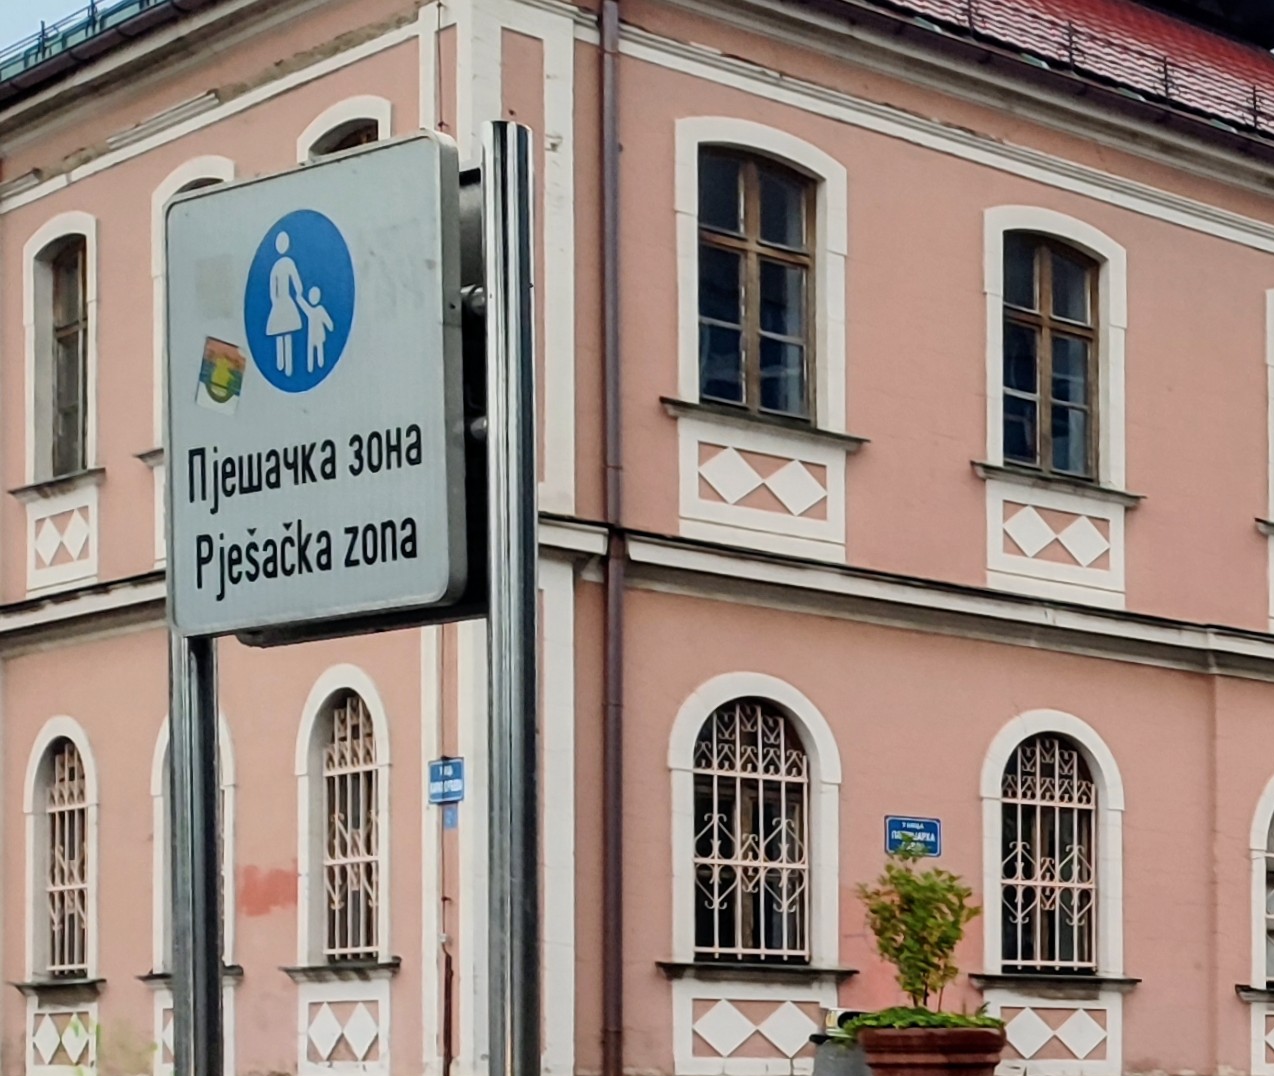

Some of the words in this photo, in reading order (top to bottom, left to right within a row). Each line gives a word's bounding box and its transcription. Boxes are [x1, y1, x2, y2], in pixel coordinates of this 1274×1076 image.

[187, 436, 337, 515] Пјешачка
[348, 423, 423, 477] зона
[196, 519, 333, 601] Pješačka
[344, 516, 418, 568] zona
